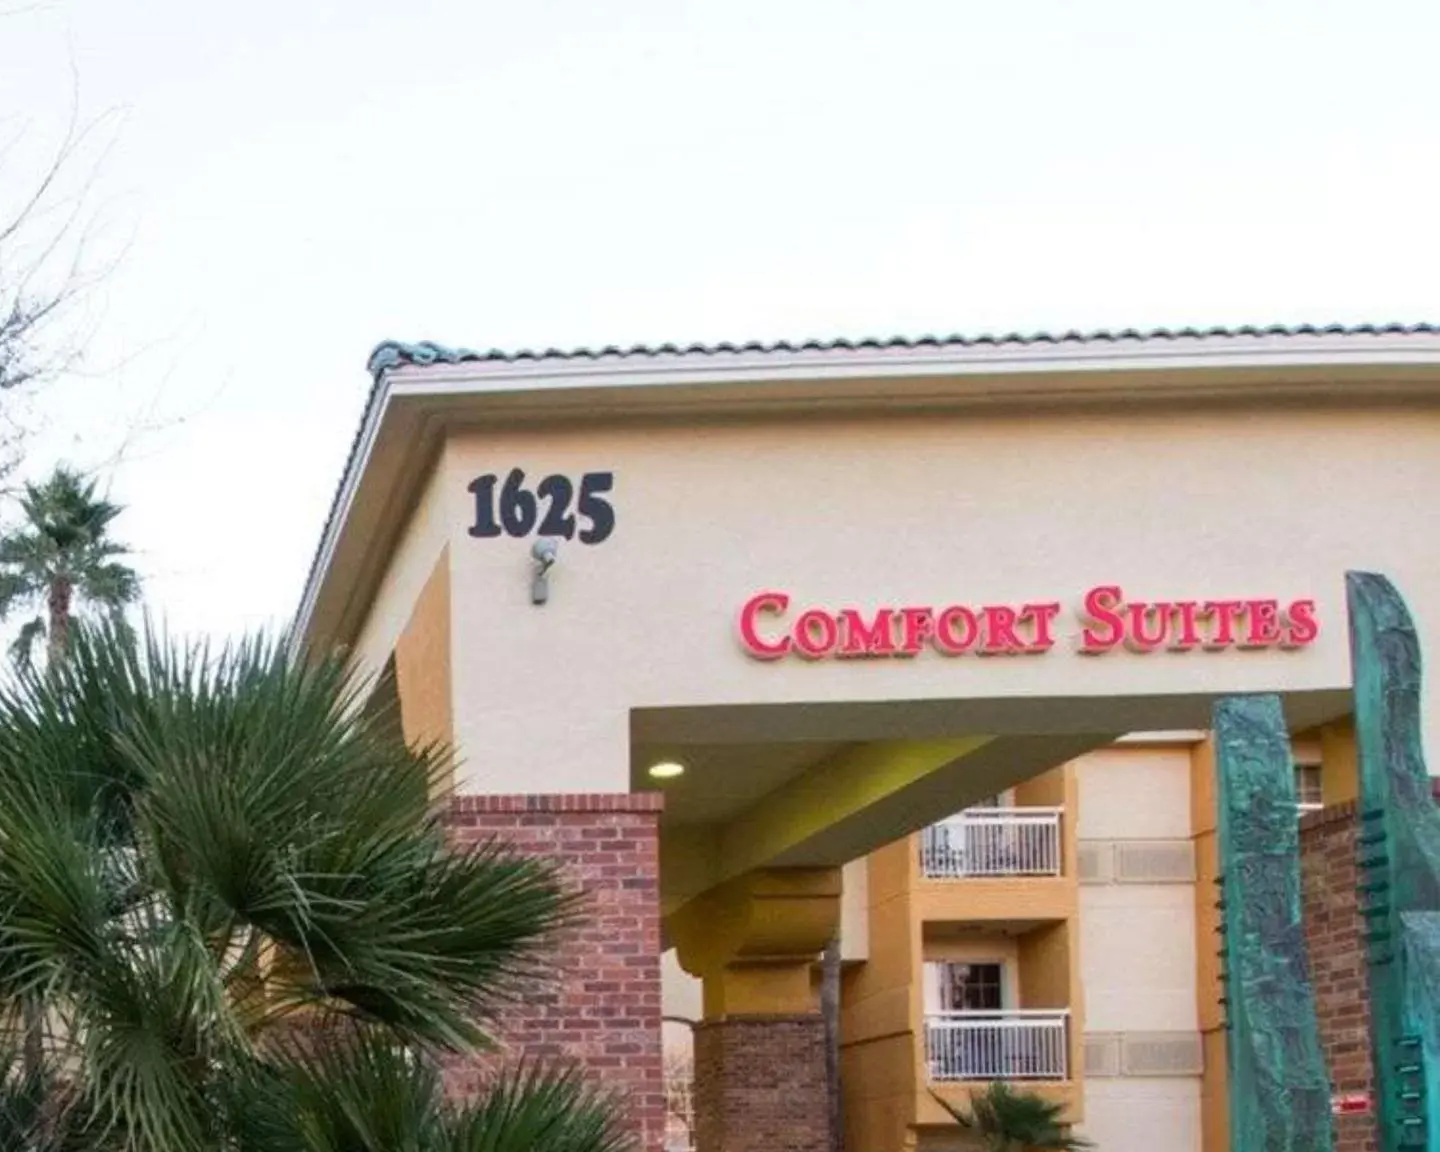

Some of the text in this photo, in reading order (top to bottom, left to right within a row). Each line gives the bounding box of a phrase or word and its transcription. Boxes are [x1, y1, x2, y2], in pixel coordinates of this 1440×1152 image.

[467, 467, 617, 546] 1625
[739, 585, 1320, 659] COMFORT SUITES
